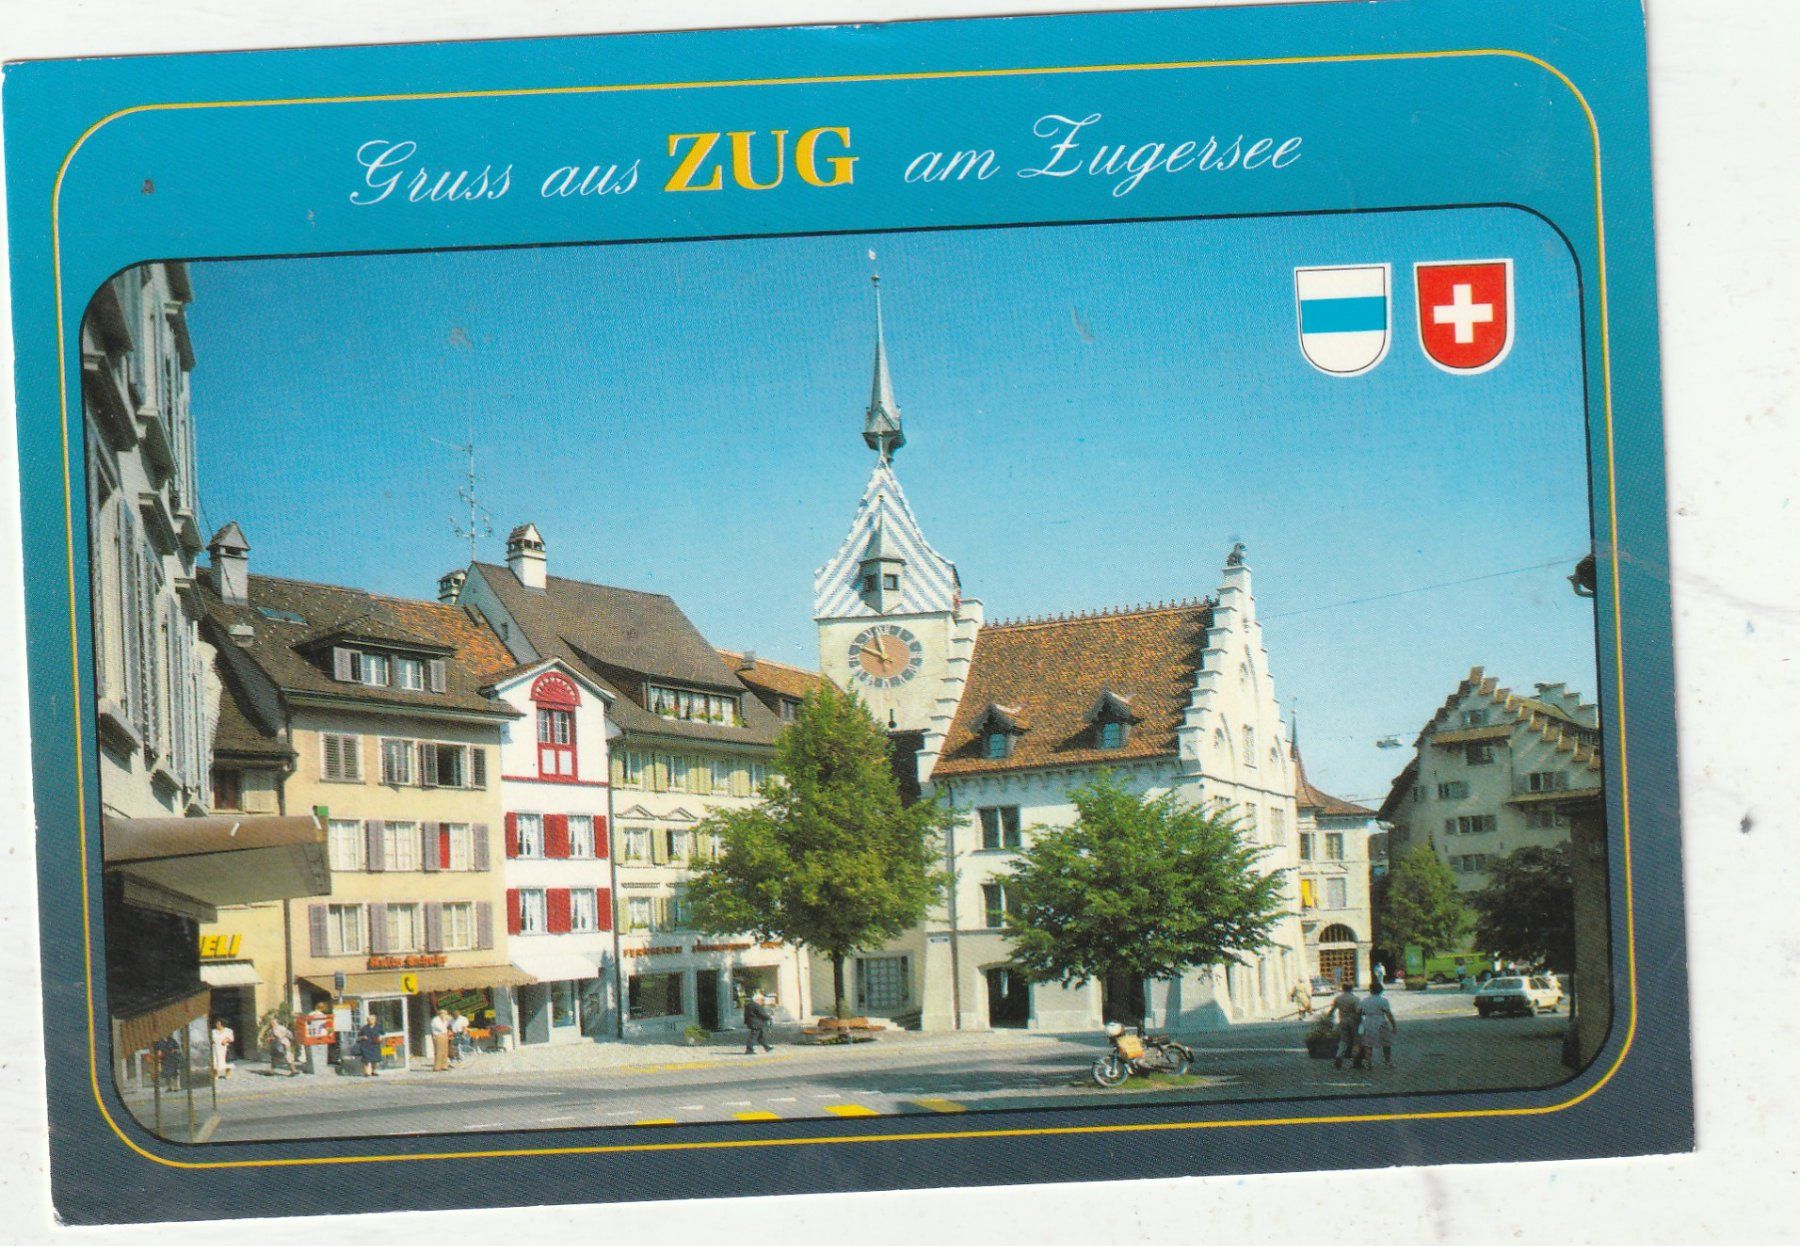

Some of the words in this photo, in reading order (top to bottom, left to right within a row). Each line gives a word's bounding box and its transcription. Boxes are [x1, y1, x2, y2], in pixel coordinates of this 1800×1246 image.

[350, 139, 513, 205] Gruss
[541, 158, 641, 198] aus
[664, 126, 860, 193] ZUG
[904, 148, 1000, 184] am
[1016, 113, 1303, 198] Zugersee
